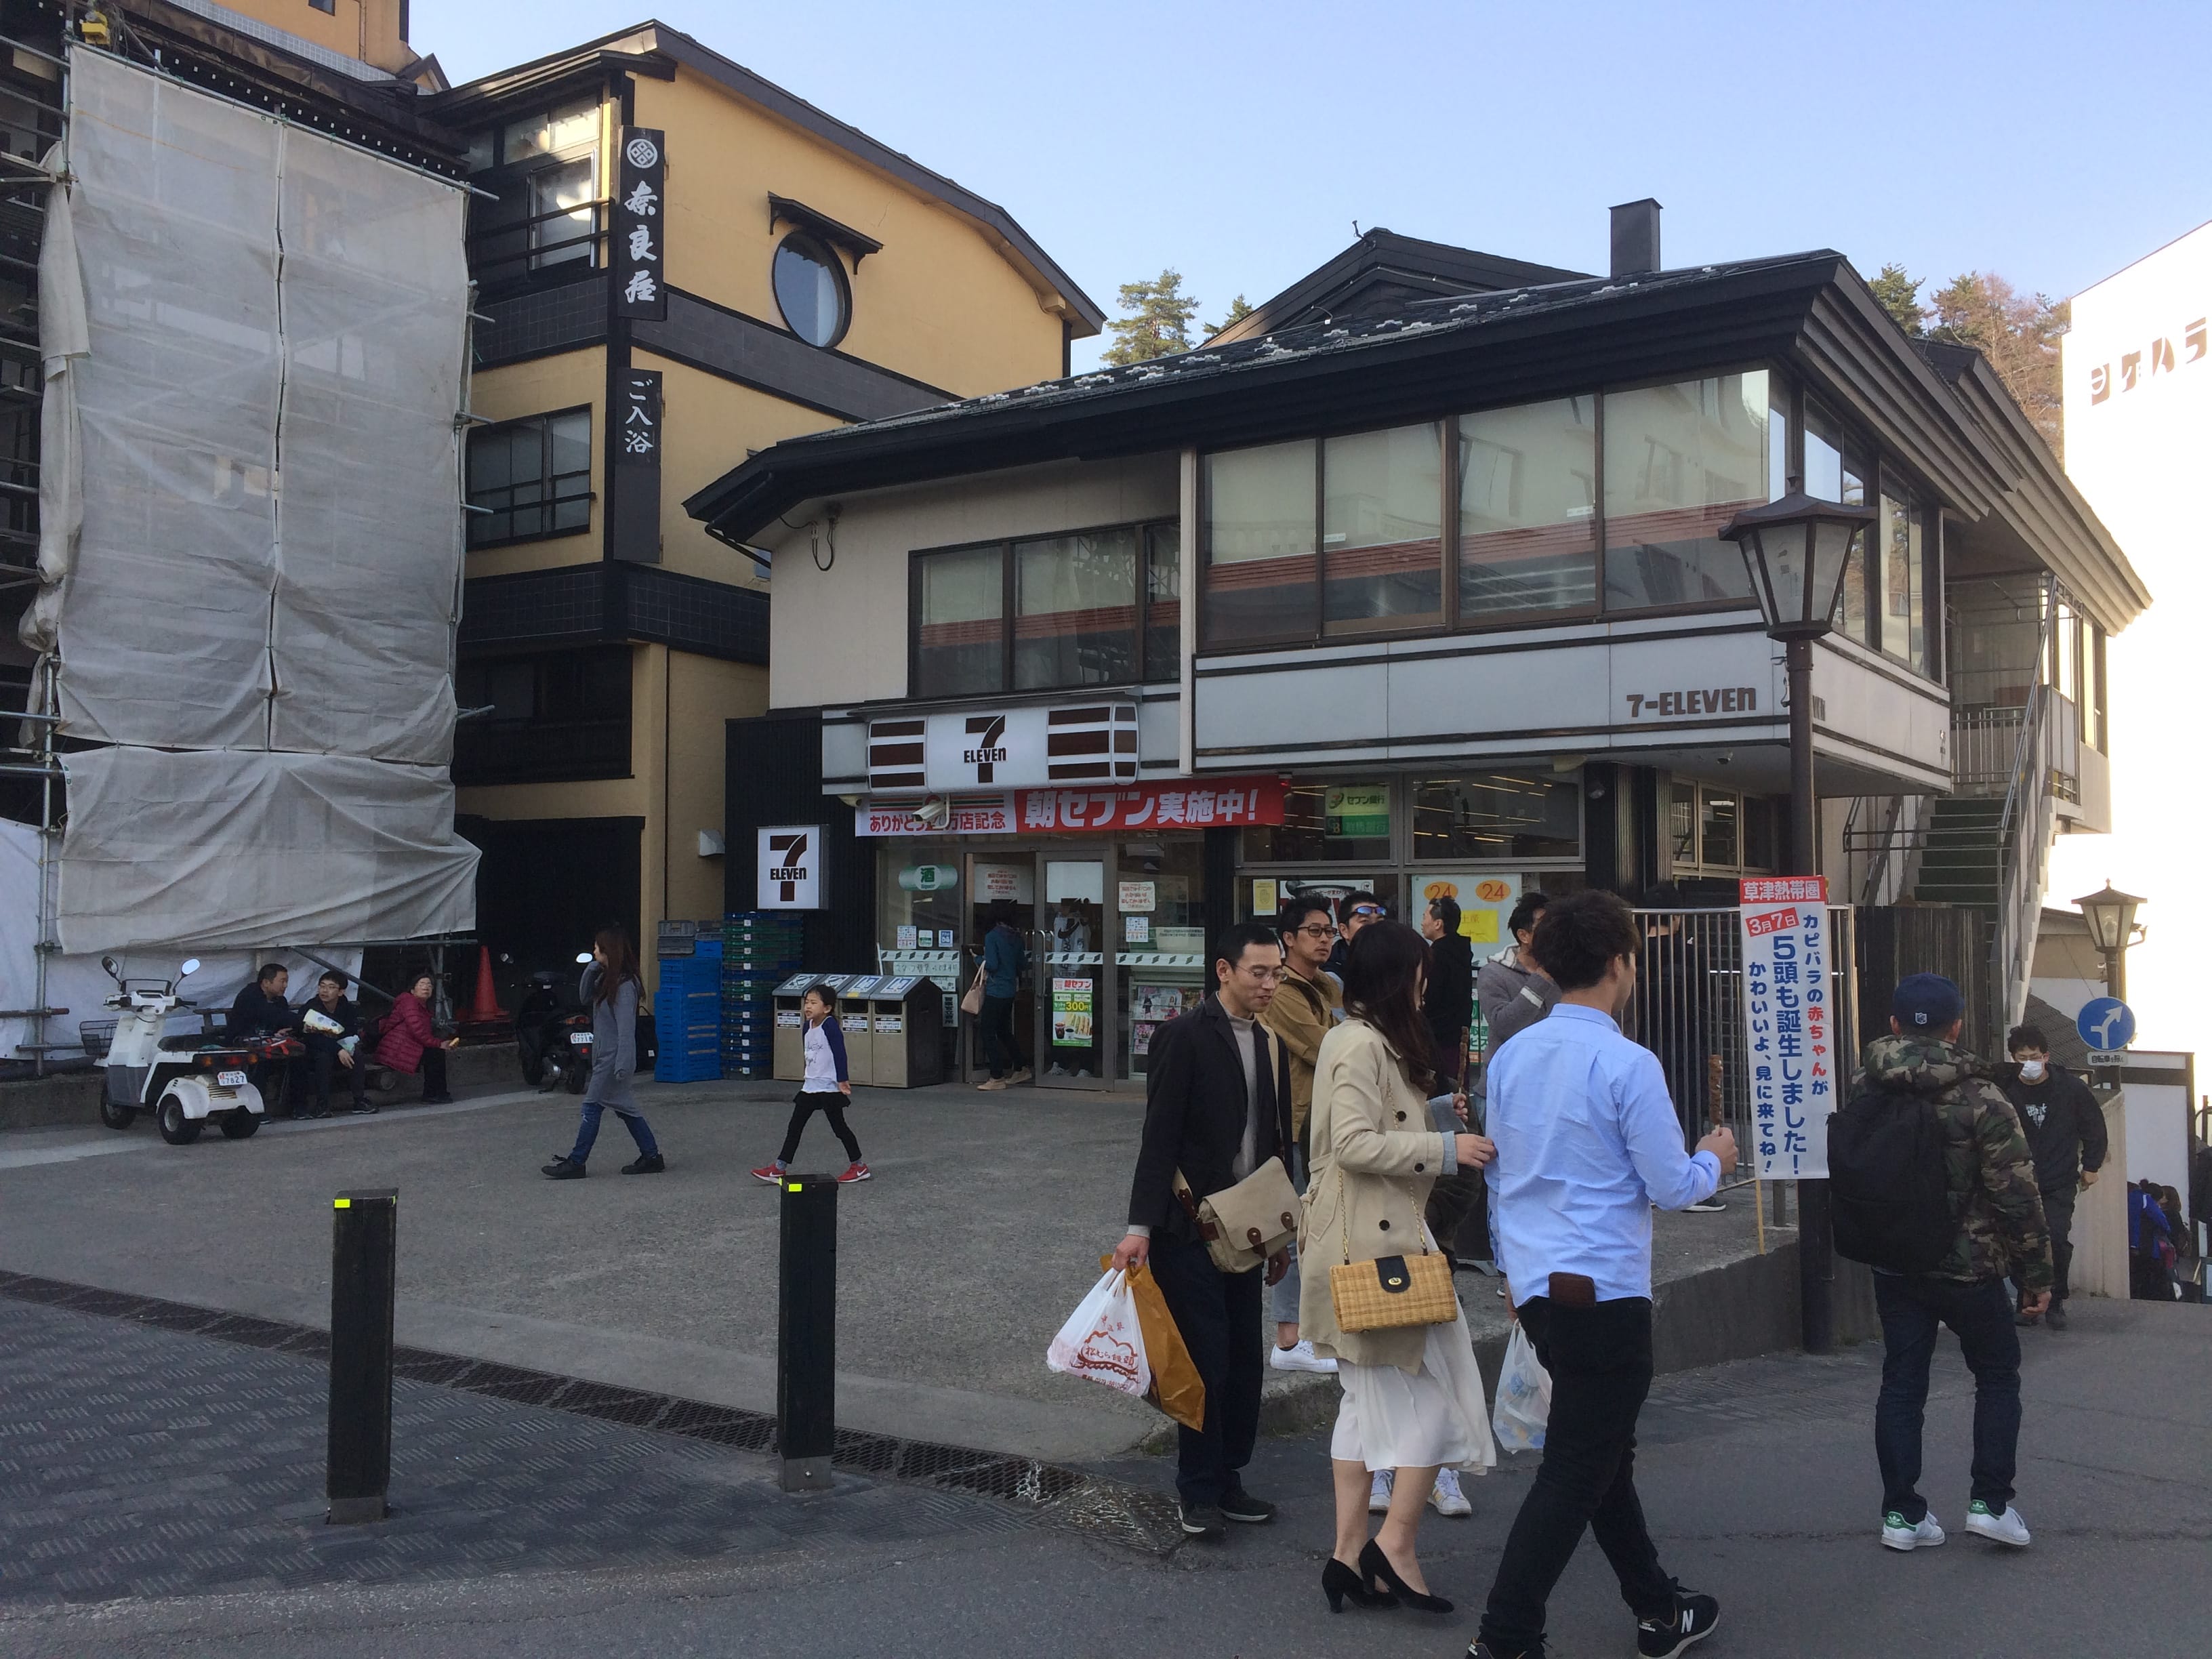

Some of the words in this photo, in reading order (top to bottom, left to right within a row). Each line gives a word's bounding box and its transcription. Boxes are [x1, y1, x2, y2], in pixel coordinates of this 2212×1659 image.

[624, 180, 658, 304] 奈良屋
[624, 379, 654, 454] ご入浴
[920, 867, 935, 883] 酒
[1482, 883, 1506, 899] 24
[1743, 880, 1820, 901] 草津熱帯圏
[1749, 912, 1796, 934] 3月7日
[1803, 915, 1828, 1095] カピバラの赤ちゃんが
[1772, 935, 1807, 1174] 5頭も誕生しました!
